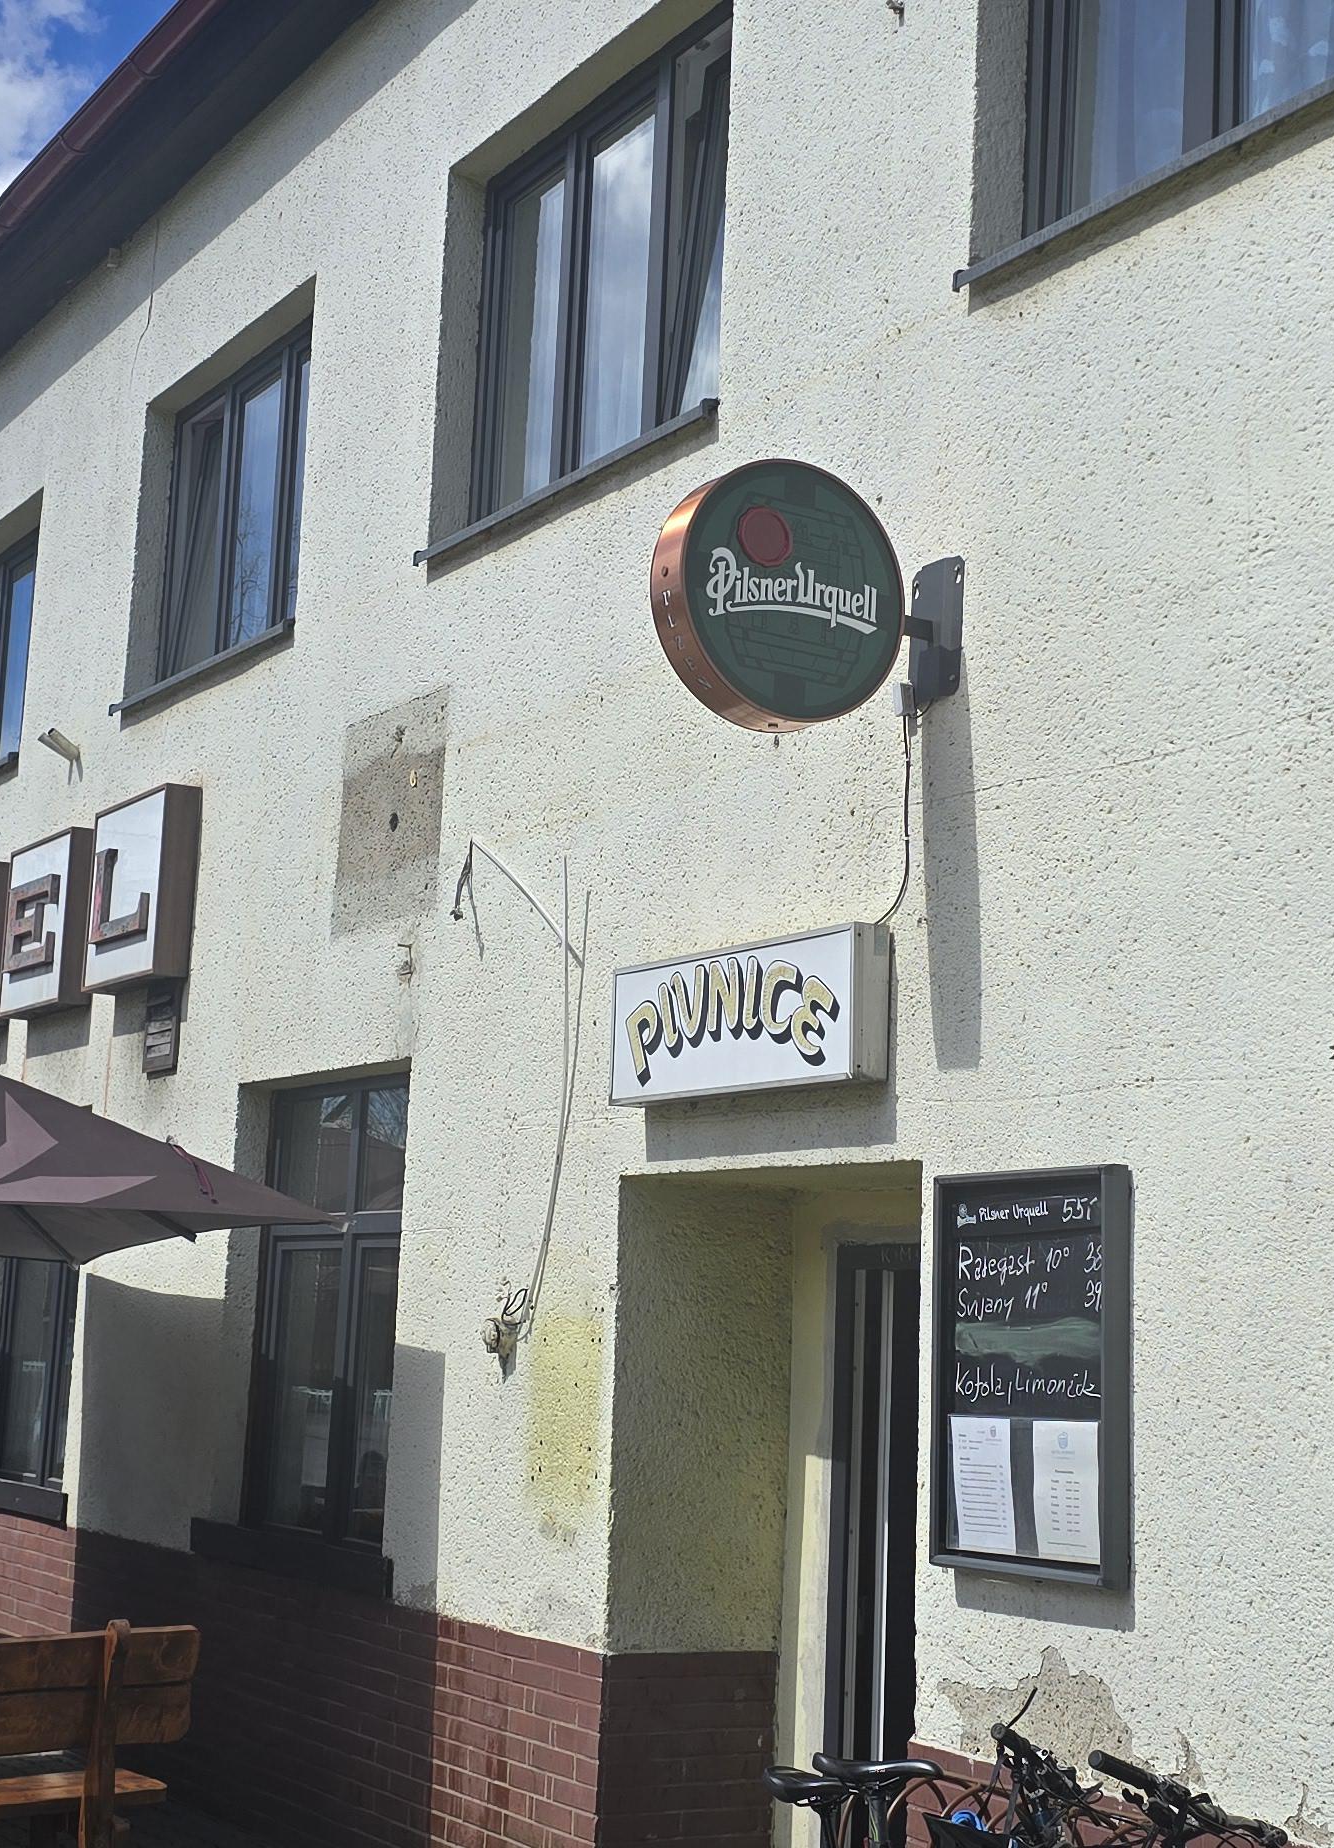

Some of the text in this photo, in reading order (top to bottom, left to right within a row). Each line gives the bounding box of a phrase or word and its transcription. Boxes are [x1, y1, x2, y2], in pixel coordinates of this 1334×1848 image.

[706, 547, 878, 628] Pilsner Urquell
[625, 955, 841, 1088] PIVNICE
[978, 1206, 1009, 1222] Pilsner
[1012, 1200, 1049, 1225] Urquell
